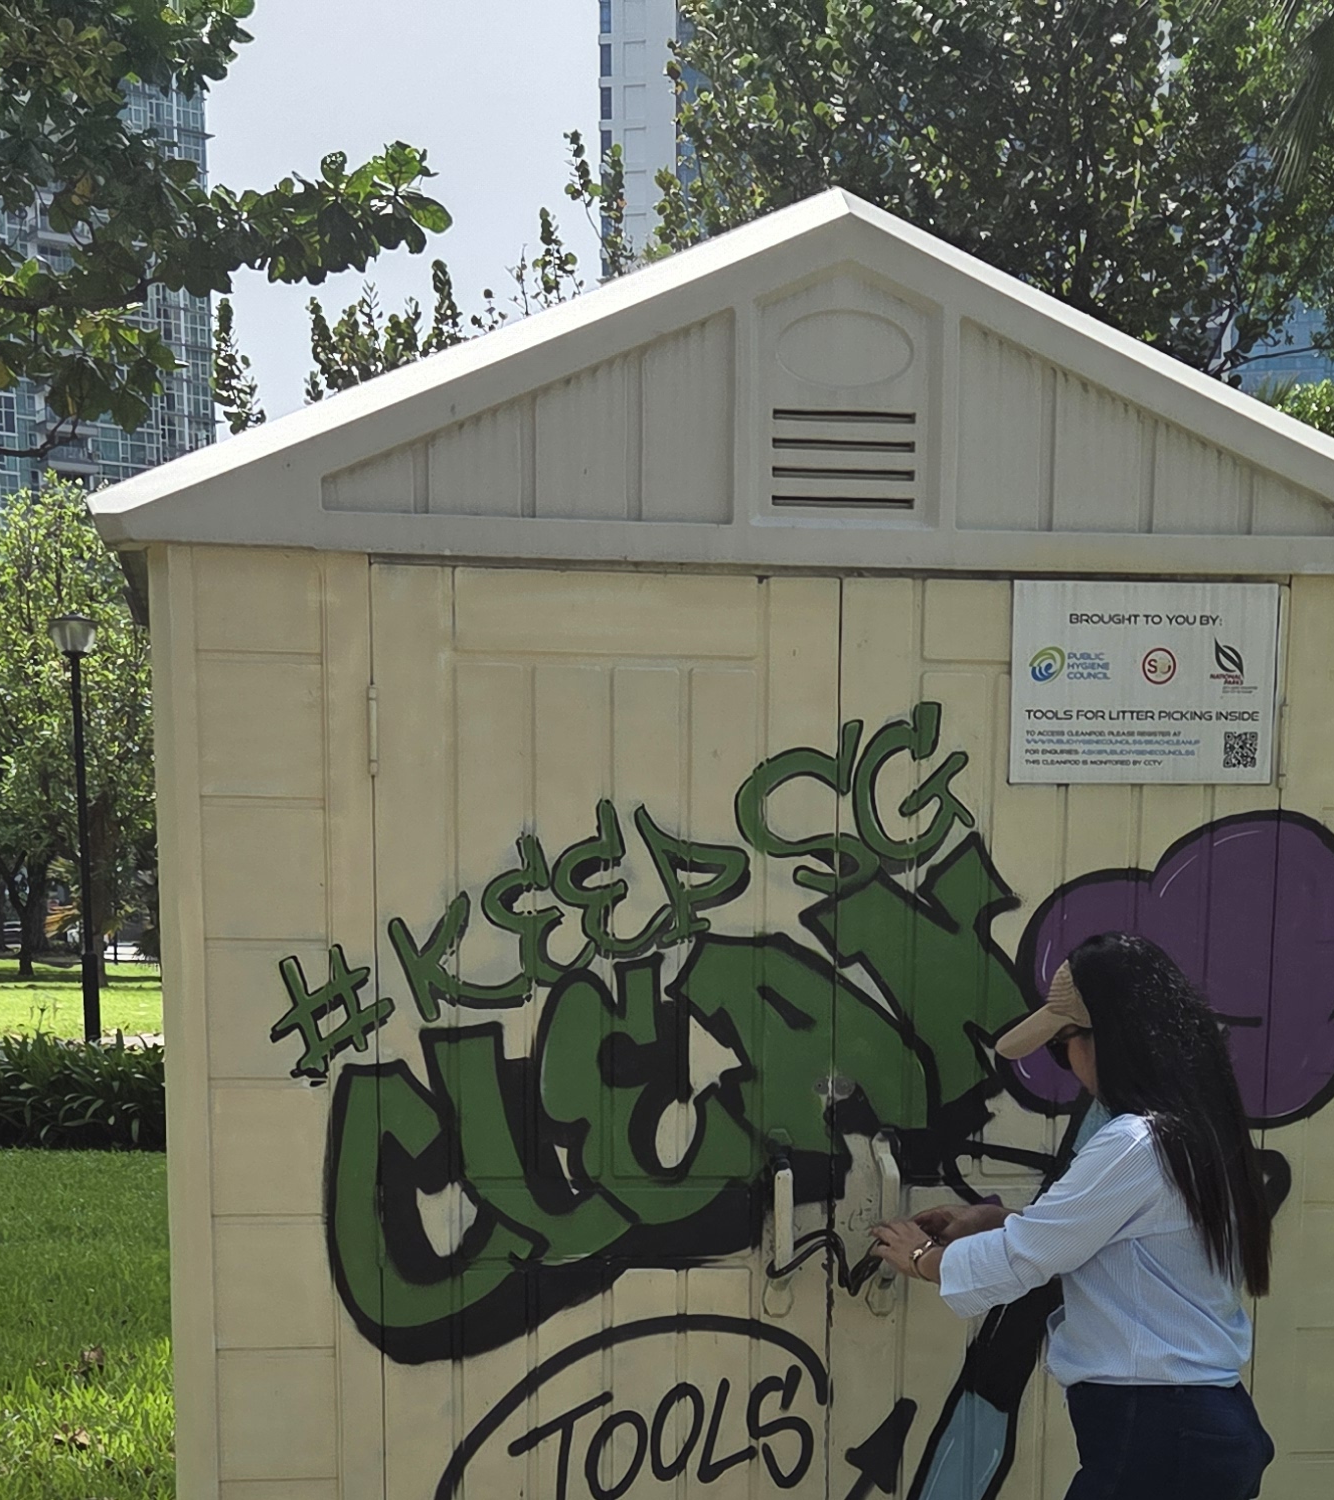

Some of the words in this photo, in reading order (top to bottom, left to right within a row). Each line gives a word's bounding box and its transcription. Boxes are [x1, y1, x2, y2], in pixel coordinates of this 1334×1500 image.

[1069, 613, 1140, 625] BROUGHT
[1143, 614, 1163, 625] TO
[1166, 614, 1197, 626] YOU
[1200, 615, 1223, 626] BY:
[1067, 652, 1105, 661] PUBLIC
[1067, 661, 1110, 671] HYGIENE
[1067, 671, 1111, 680] COUNCIL
[1025, 709, 1073, 720] TOOLS
[1076, 709, 1106, 721] FOR
[1109, 710, 1155, 721] LITTER
[1158, 710, 1213, 721] PICKING
[1215, 711, 1260, 722] INSIDE
[1137, 730, 1171, 738] REGISTER
[1025, 748, 1040, 756] FOR
[1090, 759, 1131, 767] MONITORED
[735, 700, 976, 897] SG
[323, 831, 1037, 1364] CLEAN
